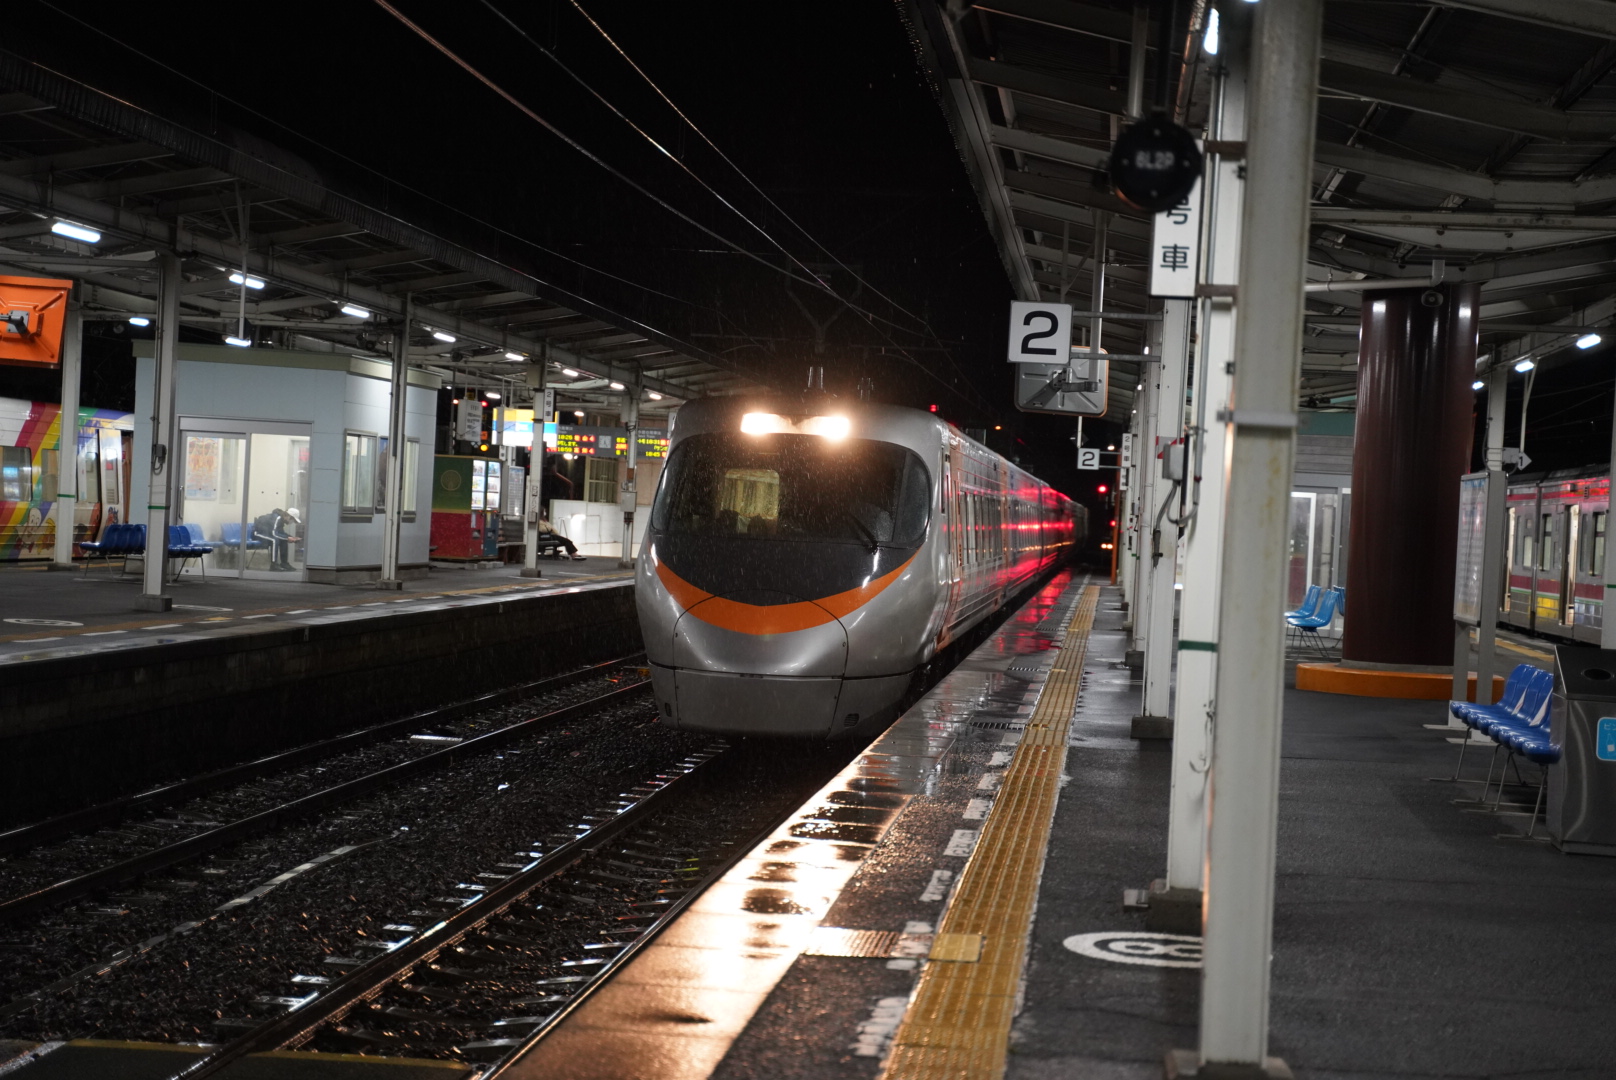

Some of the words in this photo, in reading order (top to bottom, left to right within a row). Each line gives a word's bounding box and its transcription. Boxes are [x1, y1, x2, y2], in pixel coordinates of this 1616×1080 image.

[1160, 195, 1192, 272] 号車
[1021, 310, 1058, 355] 2
[1082, 451, 1095, 467] 2
